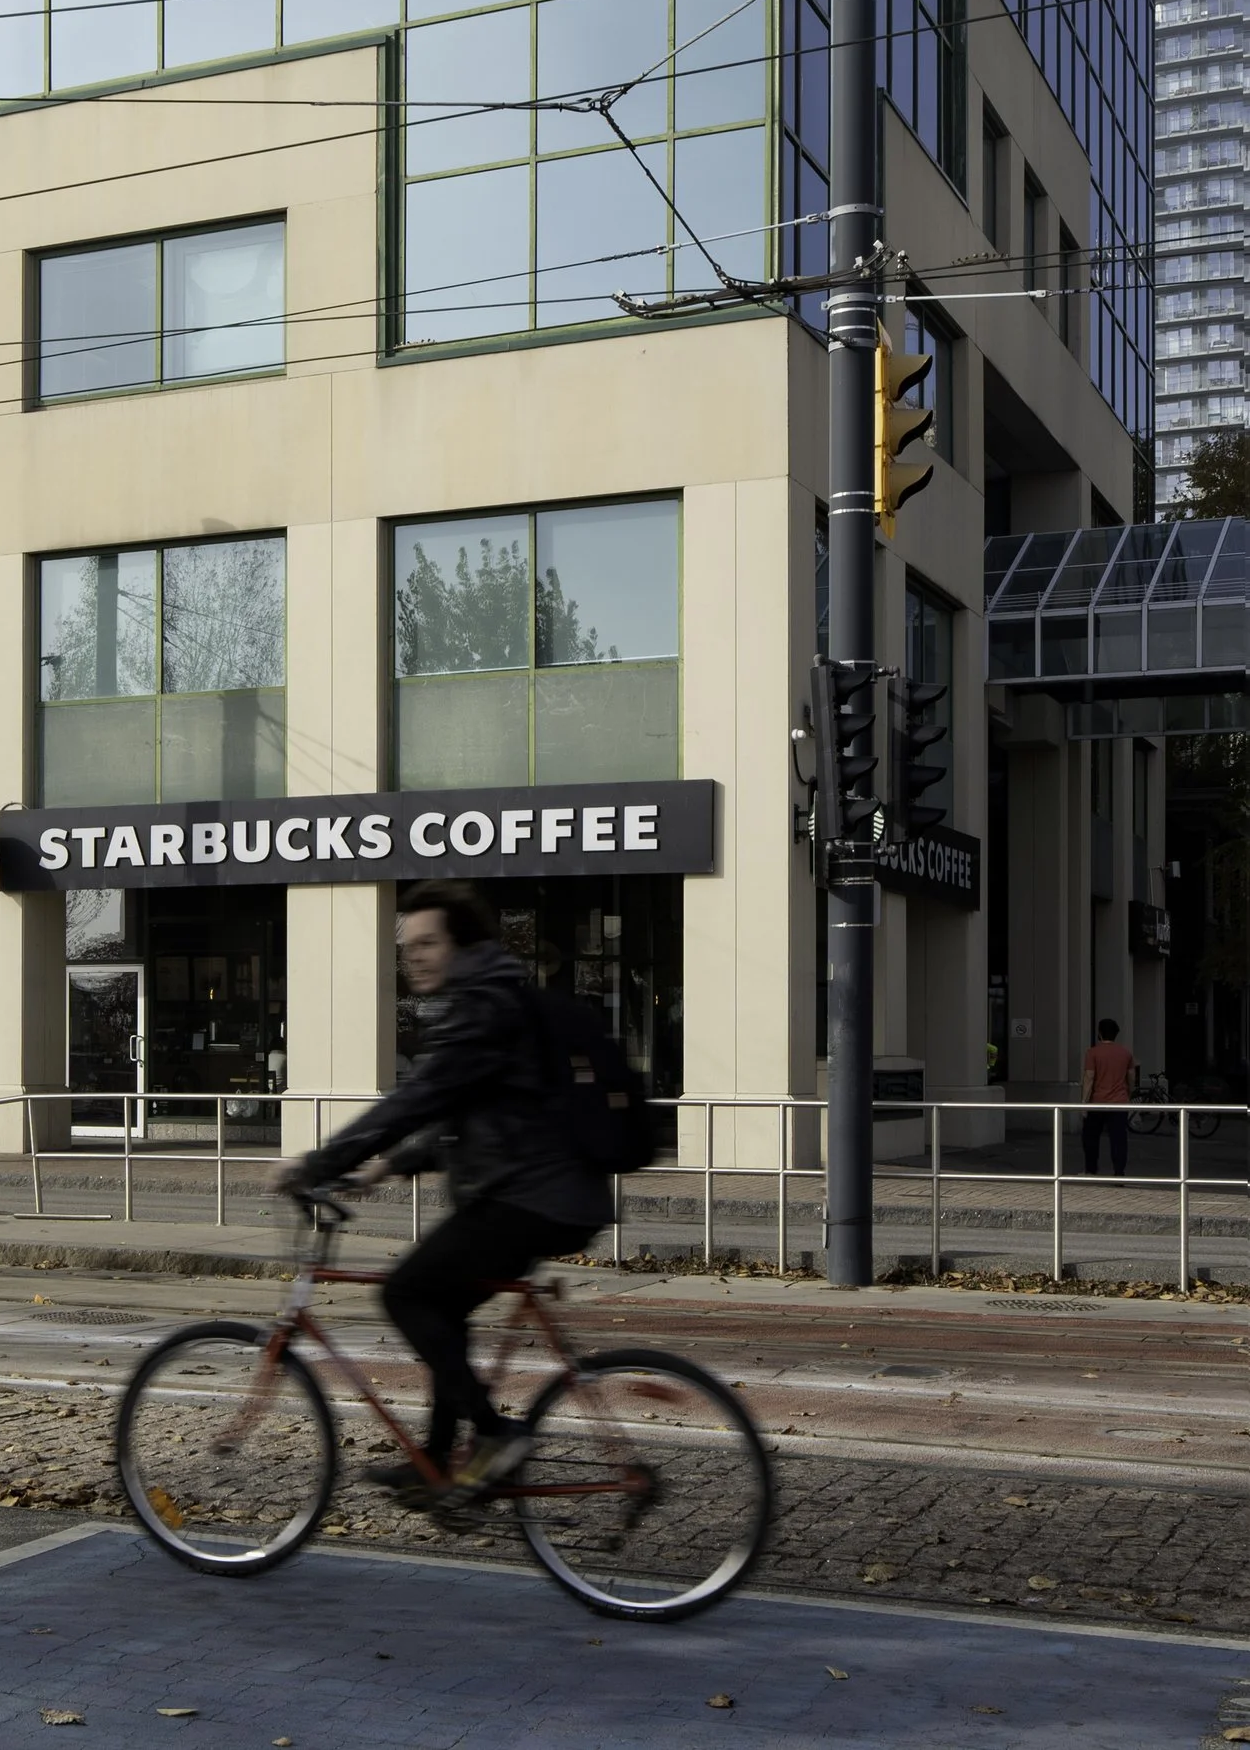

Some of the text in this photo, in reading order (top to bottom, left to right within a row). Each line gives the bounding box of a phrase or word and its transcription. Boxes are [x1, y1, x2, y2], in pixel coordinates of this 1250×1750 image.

[38, 804, 658, 870] STARBUCKS COFFEE
[927, 840, 972, 890] COFFEE
